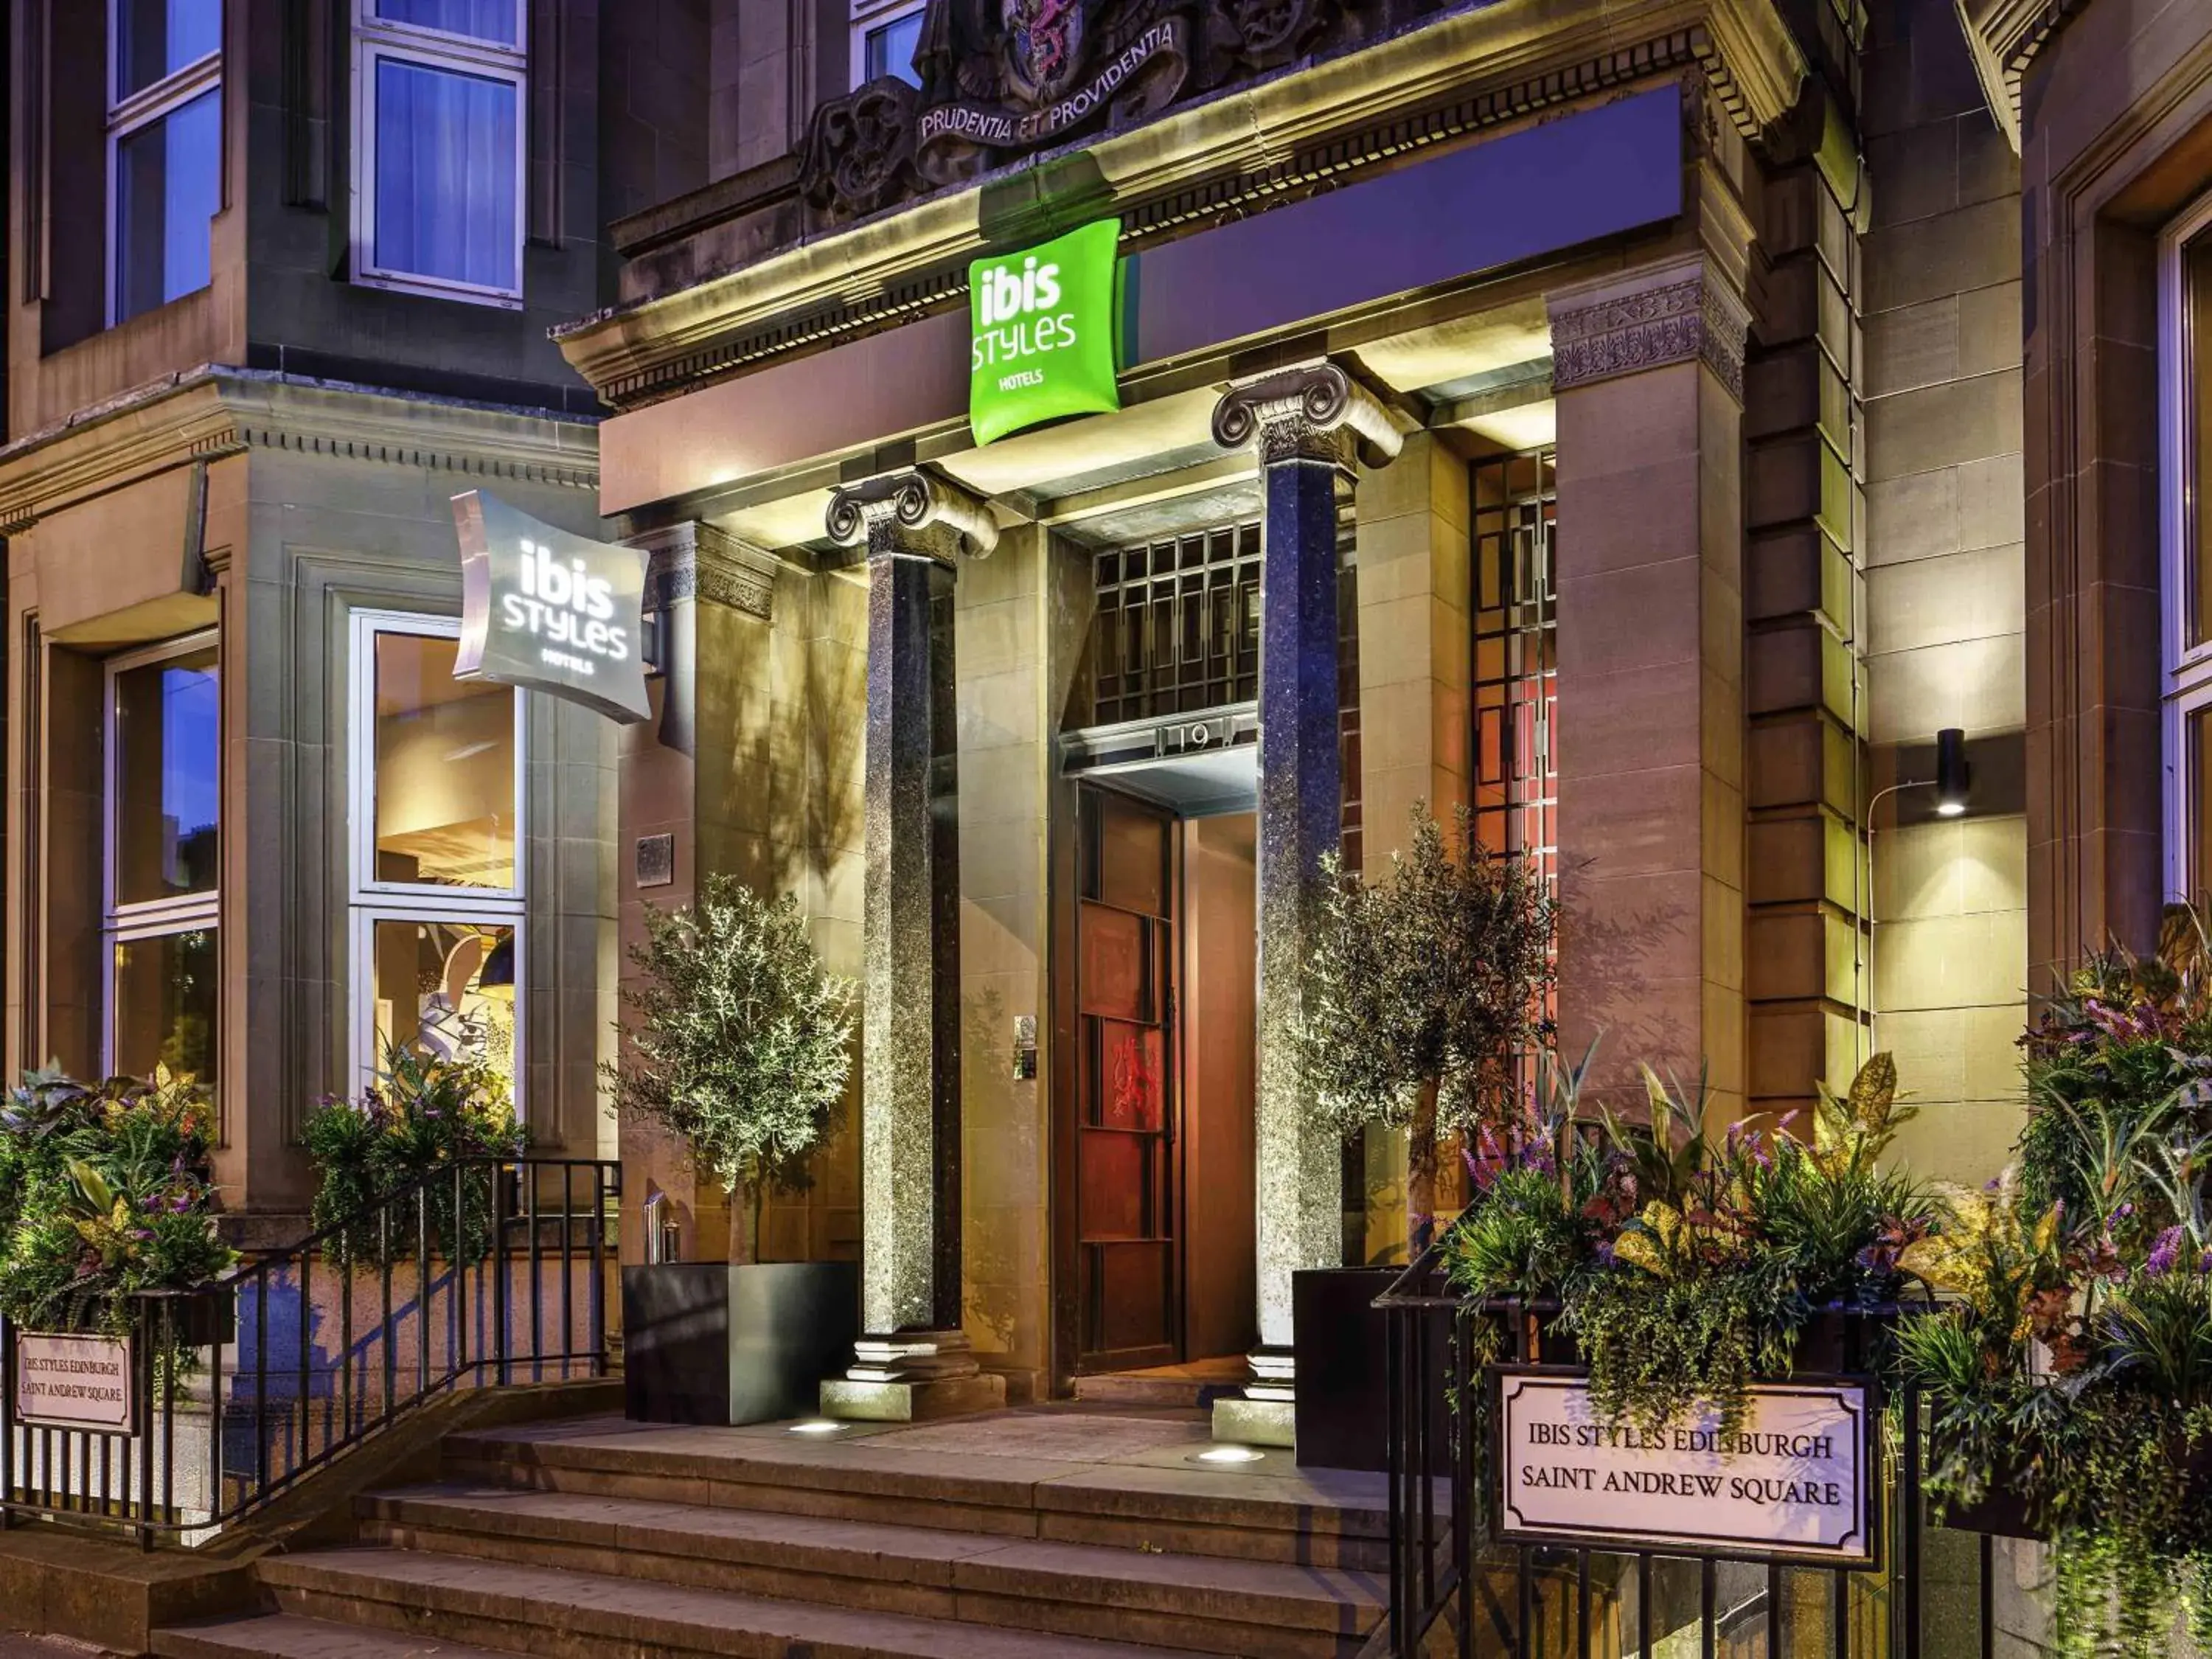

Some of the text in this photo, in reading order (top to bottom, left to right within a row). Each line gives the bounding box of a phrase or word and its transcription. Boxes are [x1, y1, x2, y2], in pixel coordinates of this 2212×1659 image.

[921, 22, 1173, 141] PRUDENTIA ET PROVIDENTIA
[981, 256, 1061, 327] ibis
[999, 369, 1044, 392] HOTELS
[519, 538, 614, 620] ibis
[39, 1358, 69, 1372] STYLES
[70, 1360, 119, 1377] EDINBURGH
[21, 1381, 123, 1402] SAINT ANDREW SQUARE
[1528, 1422, 1571, 1446] IBIS
[1576, 1425, 1666, 1451] STYLES
[1521, 1465, 1840, 1506] SAINT ANDREW SQUARE
